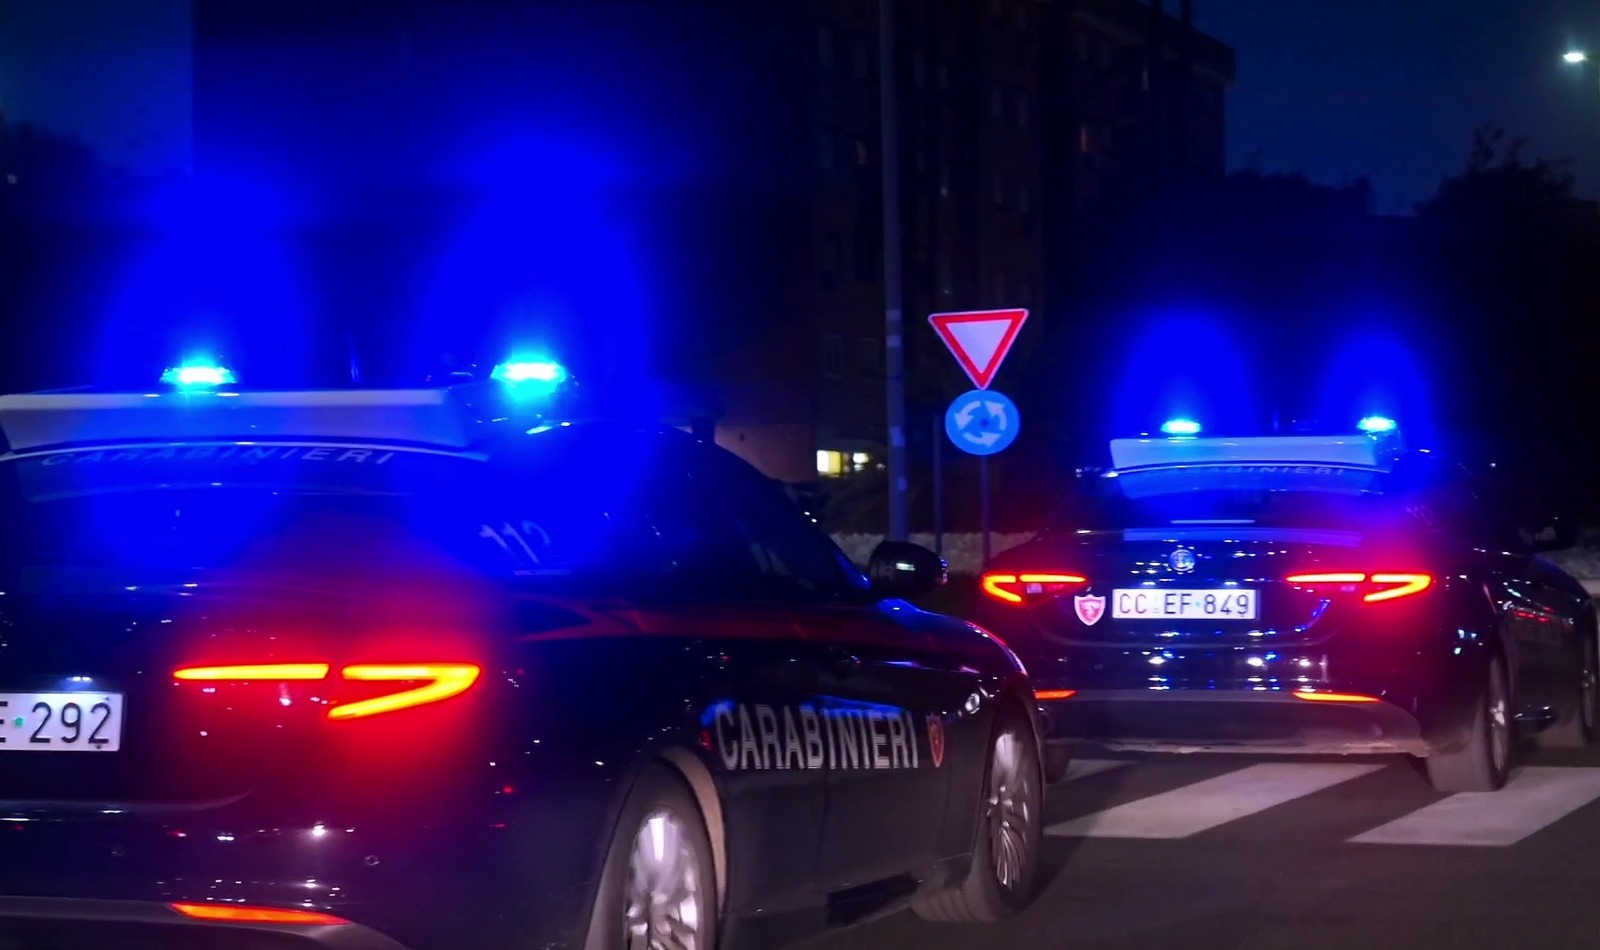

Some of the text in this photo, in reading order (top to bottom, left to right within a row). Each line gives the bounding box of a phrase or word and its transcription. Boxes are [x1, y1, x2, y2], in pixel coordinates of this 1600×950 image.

[41, 446, 394, 466] CARABINIERI
[1119, 593, 1249, 616] CC EF 849
[30, 701, 111, 744] 292
[716, 703, 918, 770] CARABINIERI
